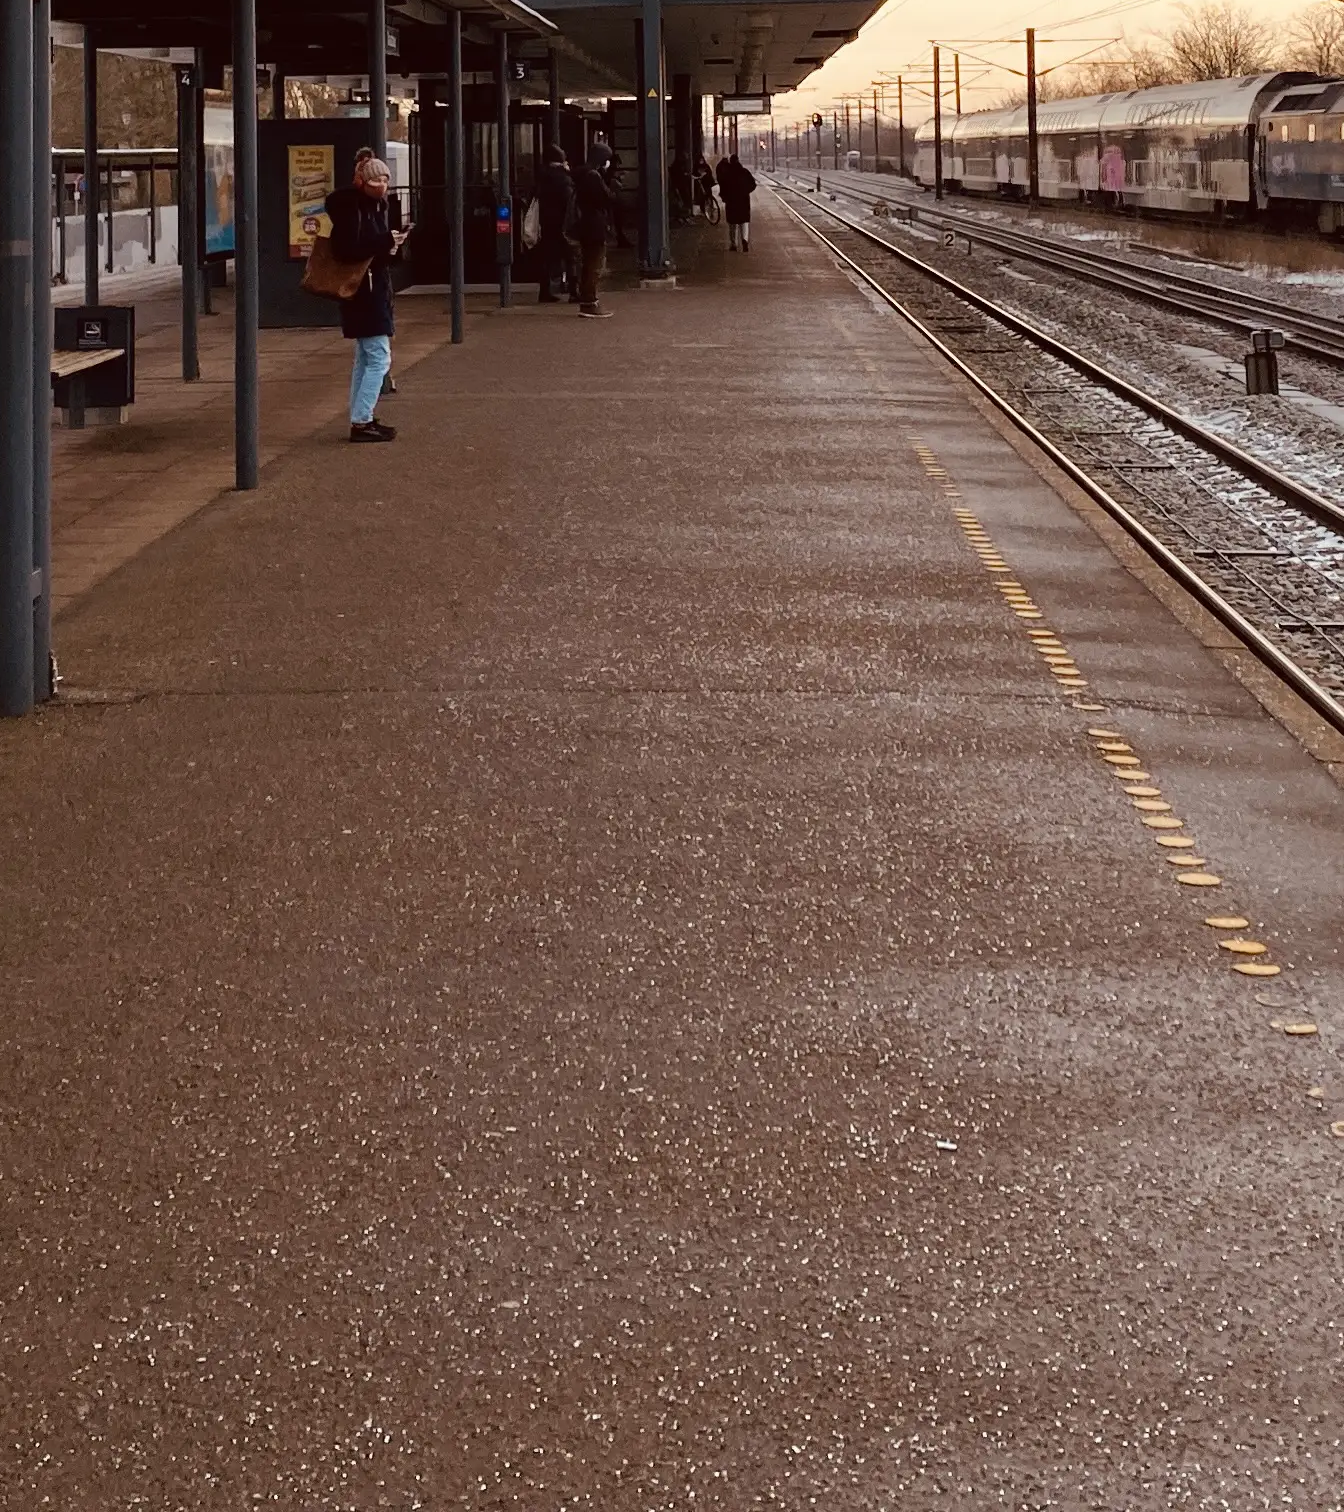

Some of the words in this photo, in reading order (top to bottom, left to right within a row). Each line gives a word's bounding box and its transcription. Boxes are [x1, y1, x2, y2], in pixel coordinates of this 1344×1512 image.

[515, 67, 525, 79] 3
[181, 74, 190, 86] 4
[944, 233, 954, 246] 2
